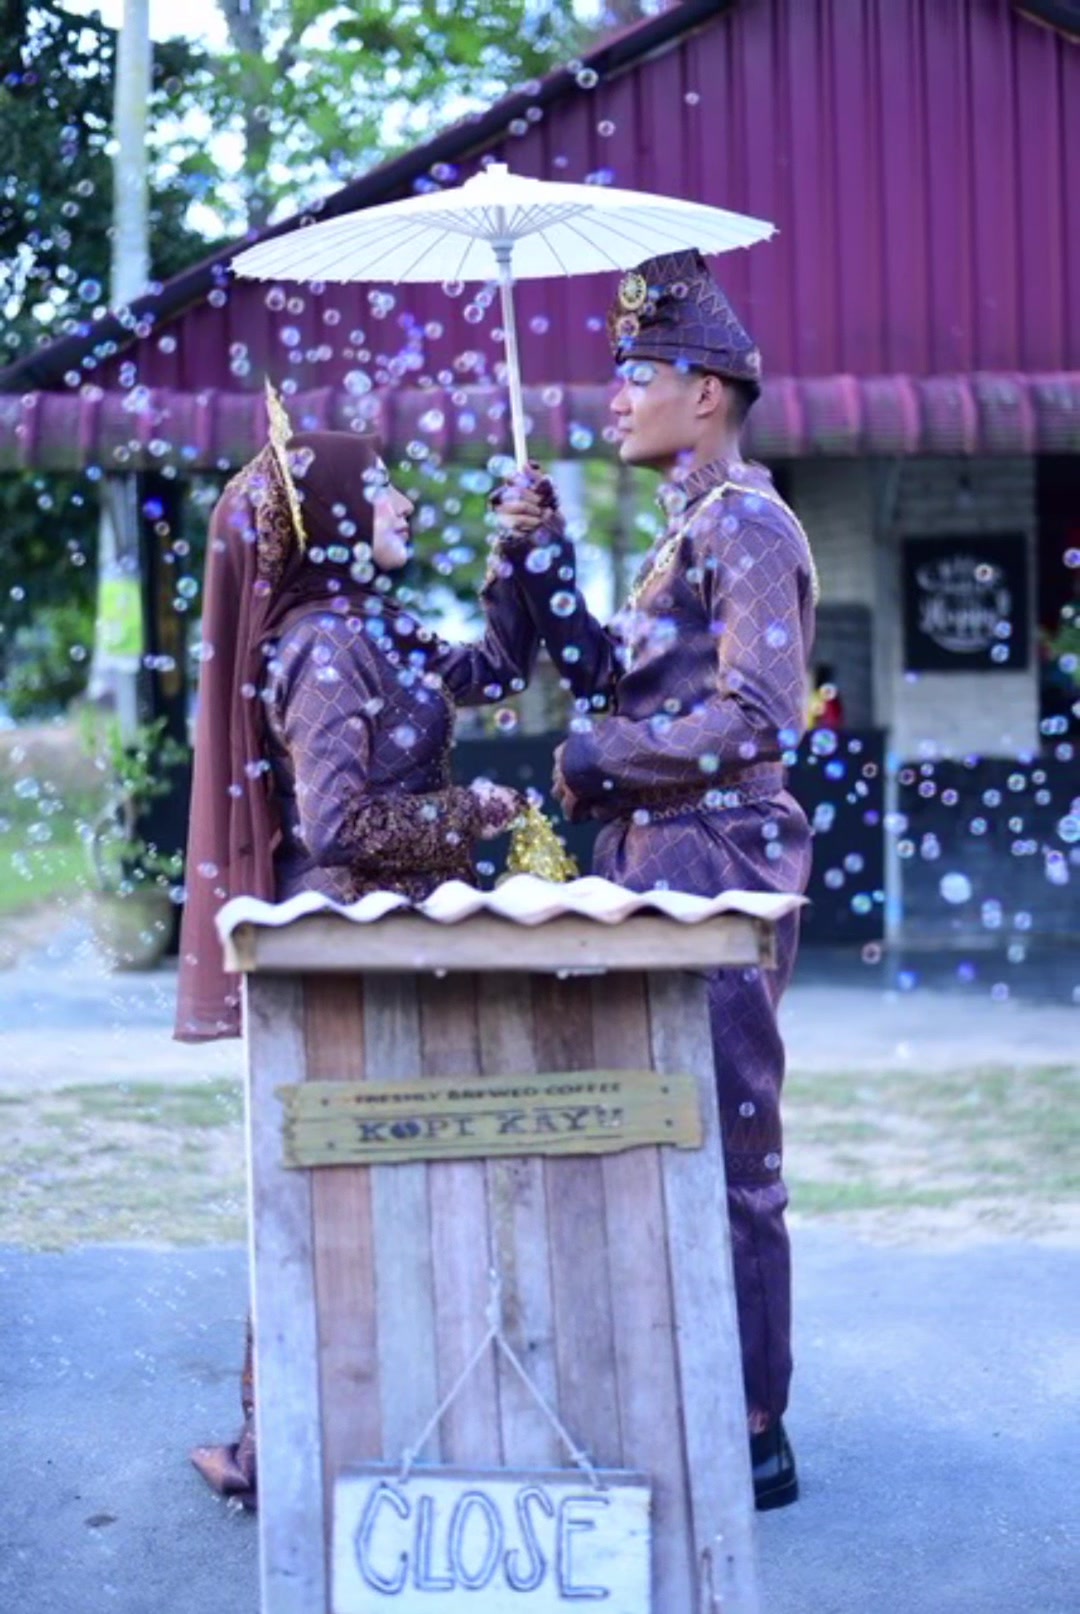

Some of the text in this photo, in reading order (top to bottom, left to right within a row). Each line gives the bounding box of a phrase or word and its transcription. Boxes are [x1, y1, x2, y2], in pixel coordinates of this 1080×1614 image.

[354, 1082, 621, 1104] FRESHLY BREWED COFFEE
[358, 1117, 476, 1142] KOPI
[354, 1481, 612, 1601] CLOSE
